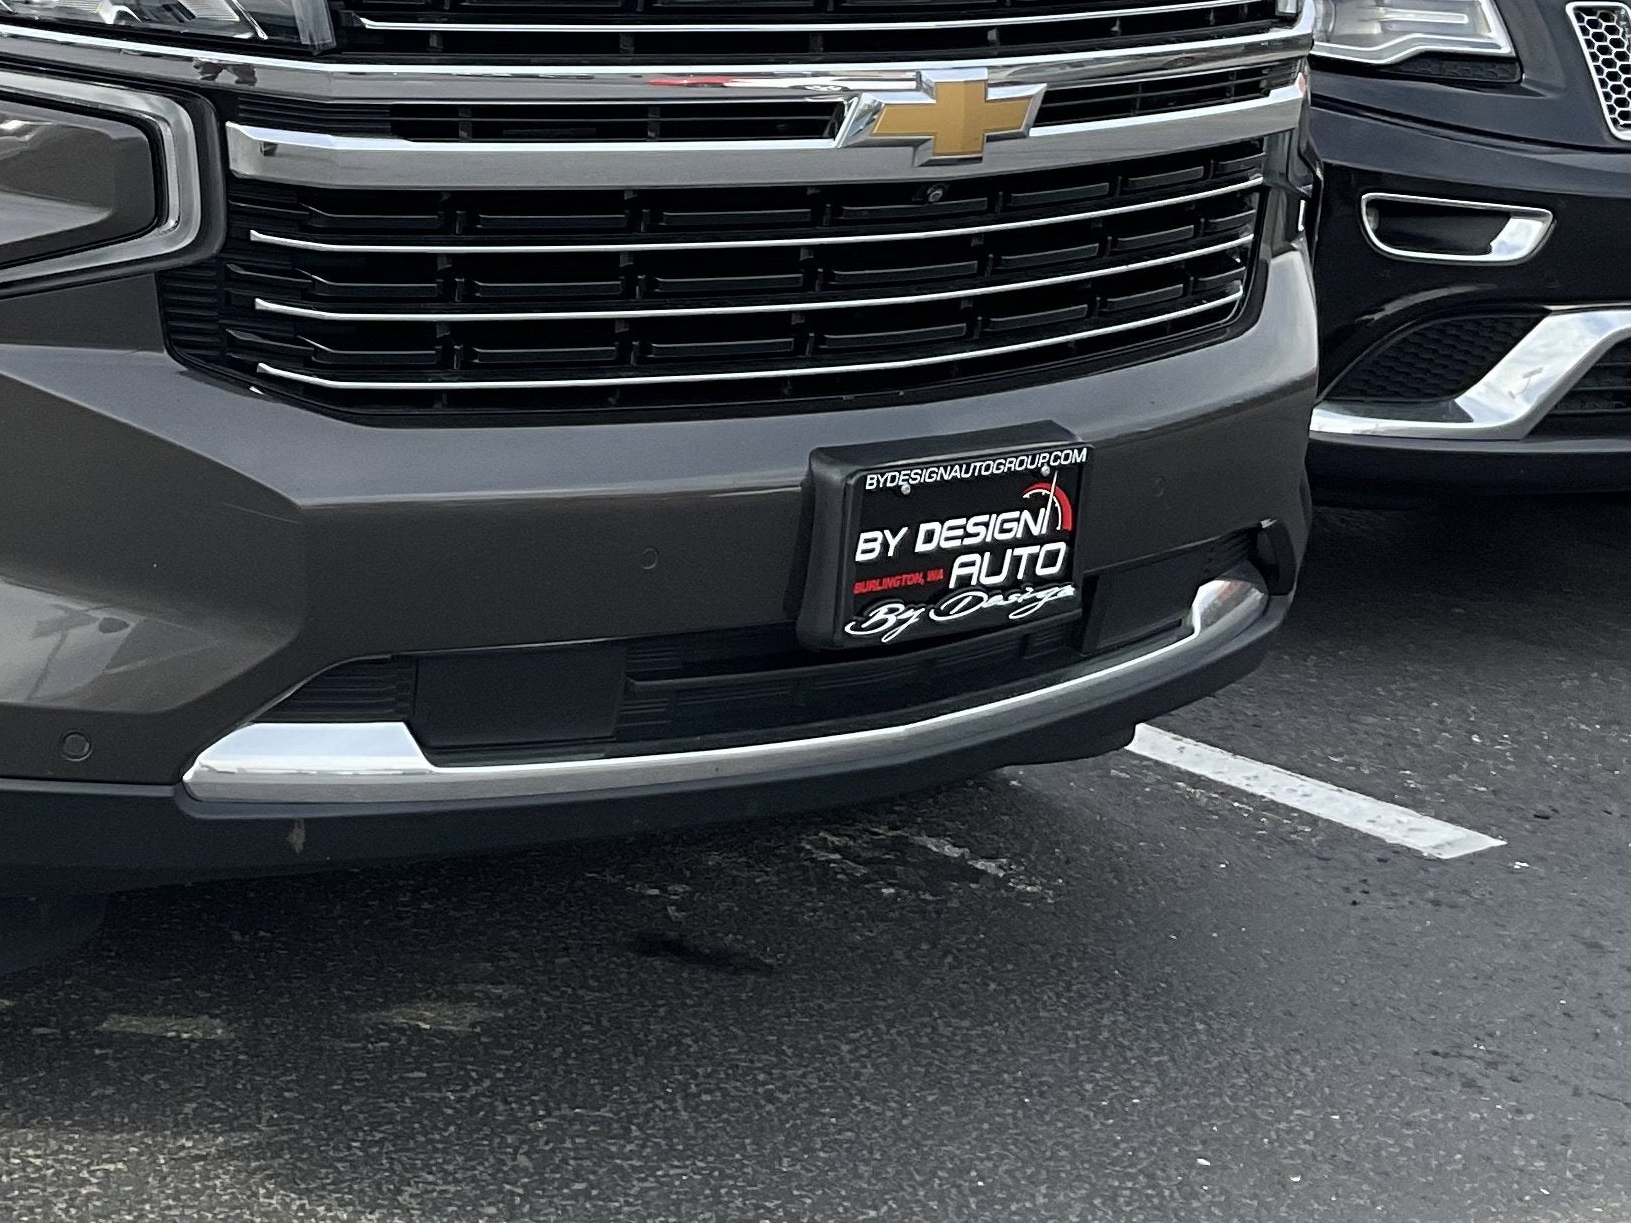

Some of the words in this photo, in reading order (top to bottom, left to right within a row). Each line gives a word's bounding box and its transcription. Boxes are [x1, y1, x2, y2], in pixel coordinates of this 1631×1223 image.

[865, 448, 1087, 489] BYDESIGNAUTOGROUP.COM
[855, 528, 908, 562] BY
[915, 507, 1047, 553] DESIGN
[949, 542, 1067, 589] AUTO
[844, 603, 926, 643] By
